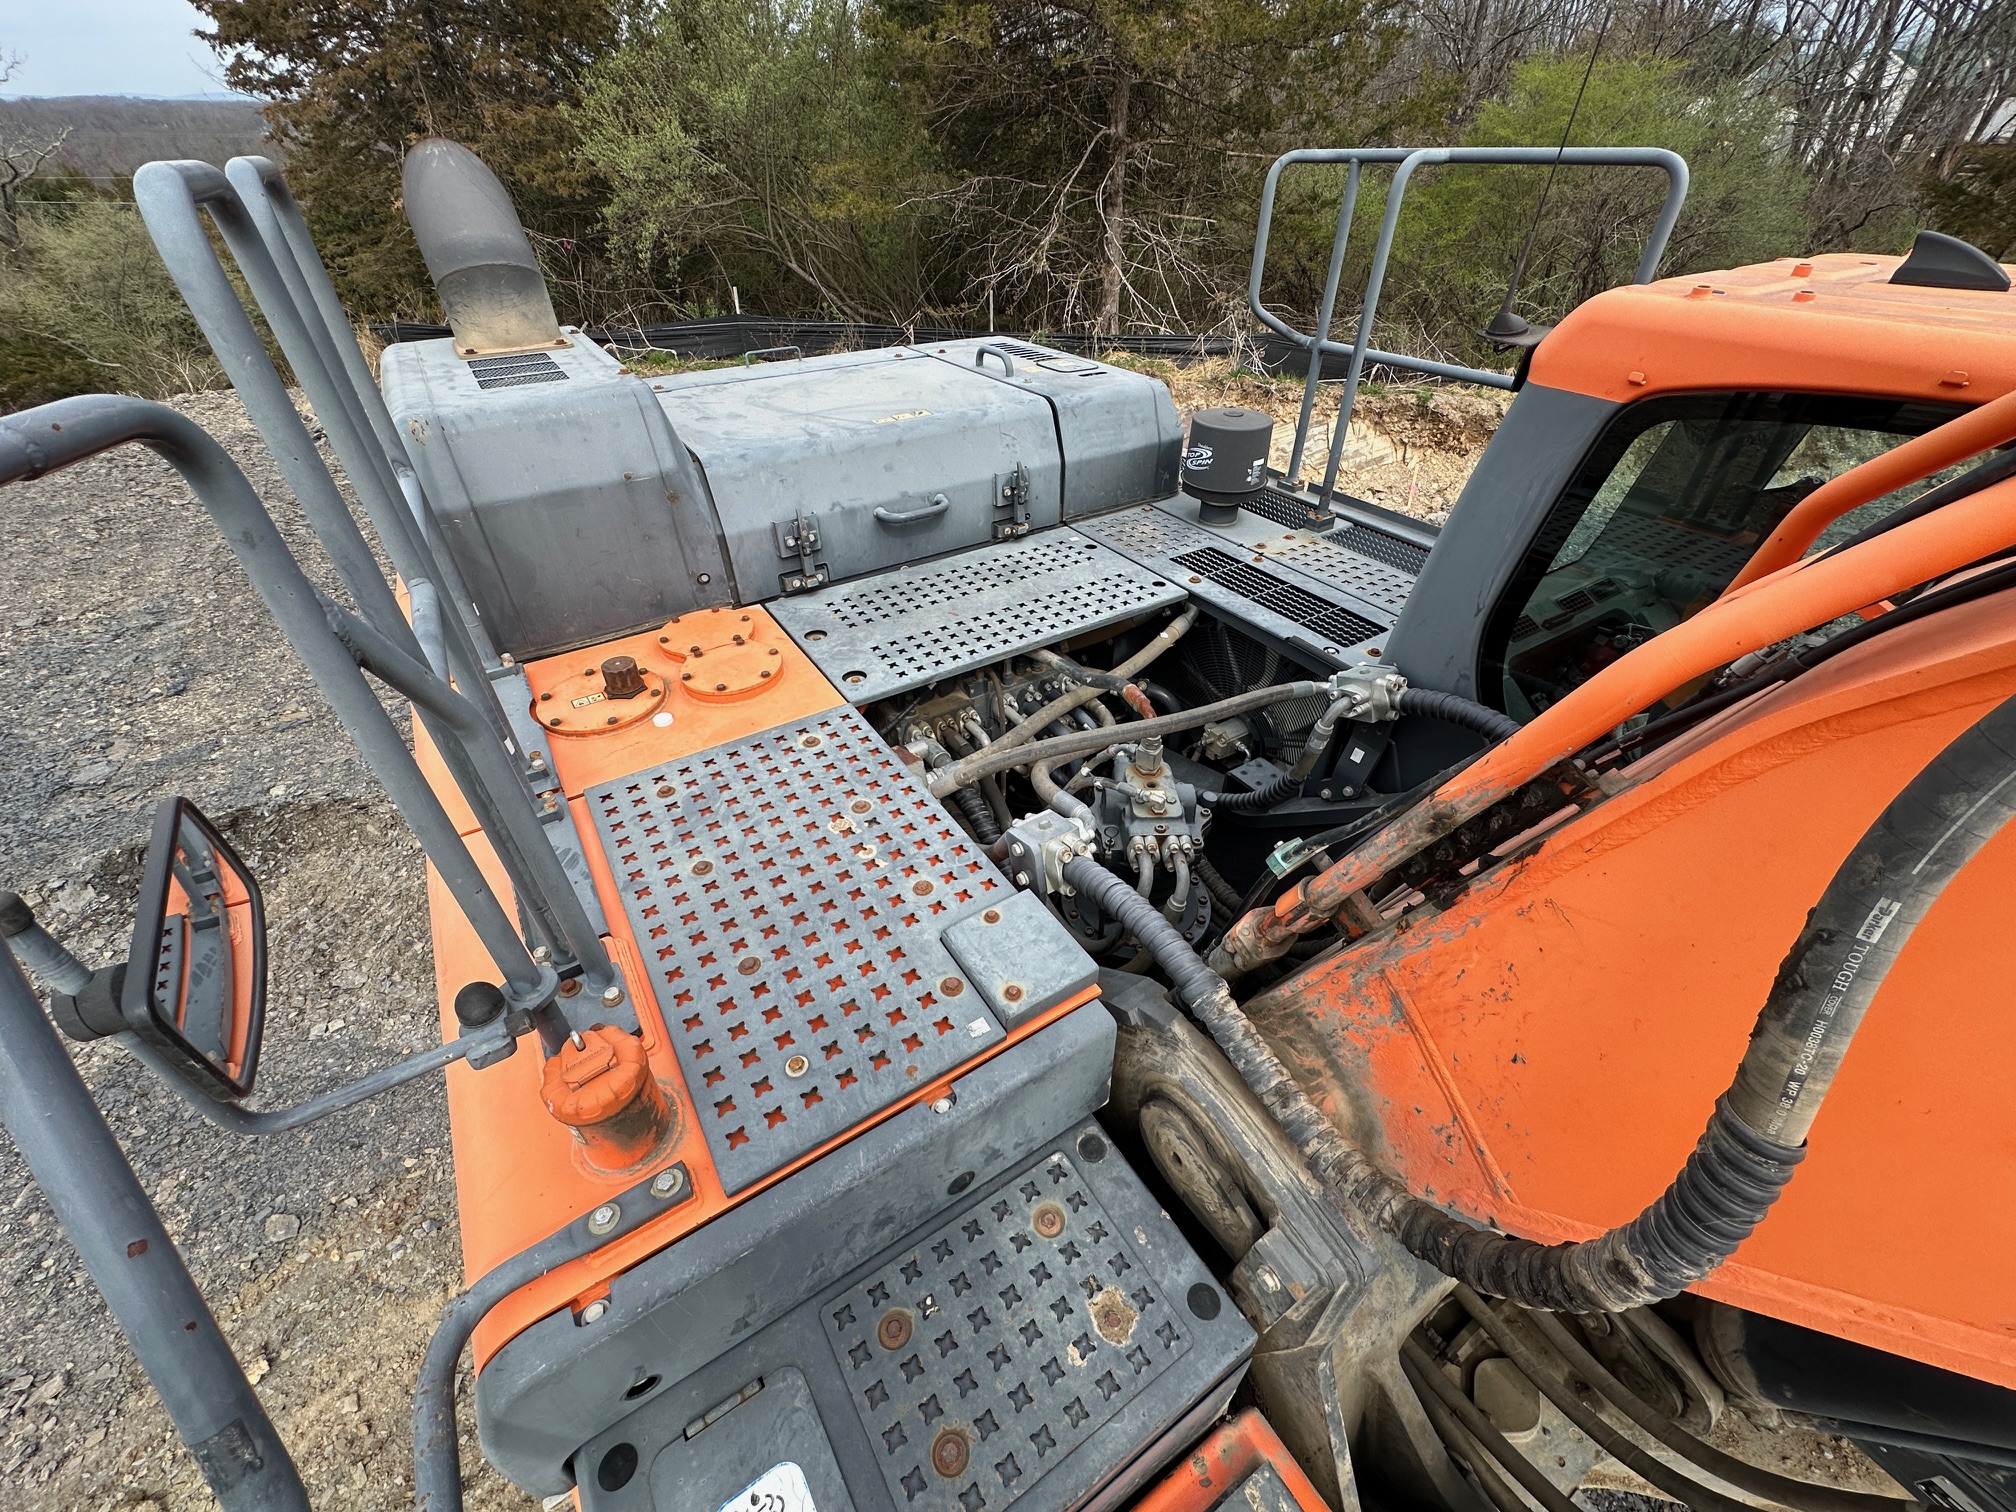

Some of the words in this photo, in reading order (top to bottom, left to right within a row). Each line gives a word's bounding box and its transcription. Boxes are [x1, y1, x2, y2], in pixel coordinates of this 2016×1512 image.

[1191, 458, 1214, 466] SPIN
[1859, 899, 1897, 941] Parker
[1832, 944, 1870, 992] TOUGH
[1822, 995, 1839, 1016] COVER
[1785, 1080, 1802, 1097] WP
